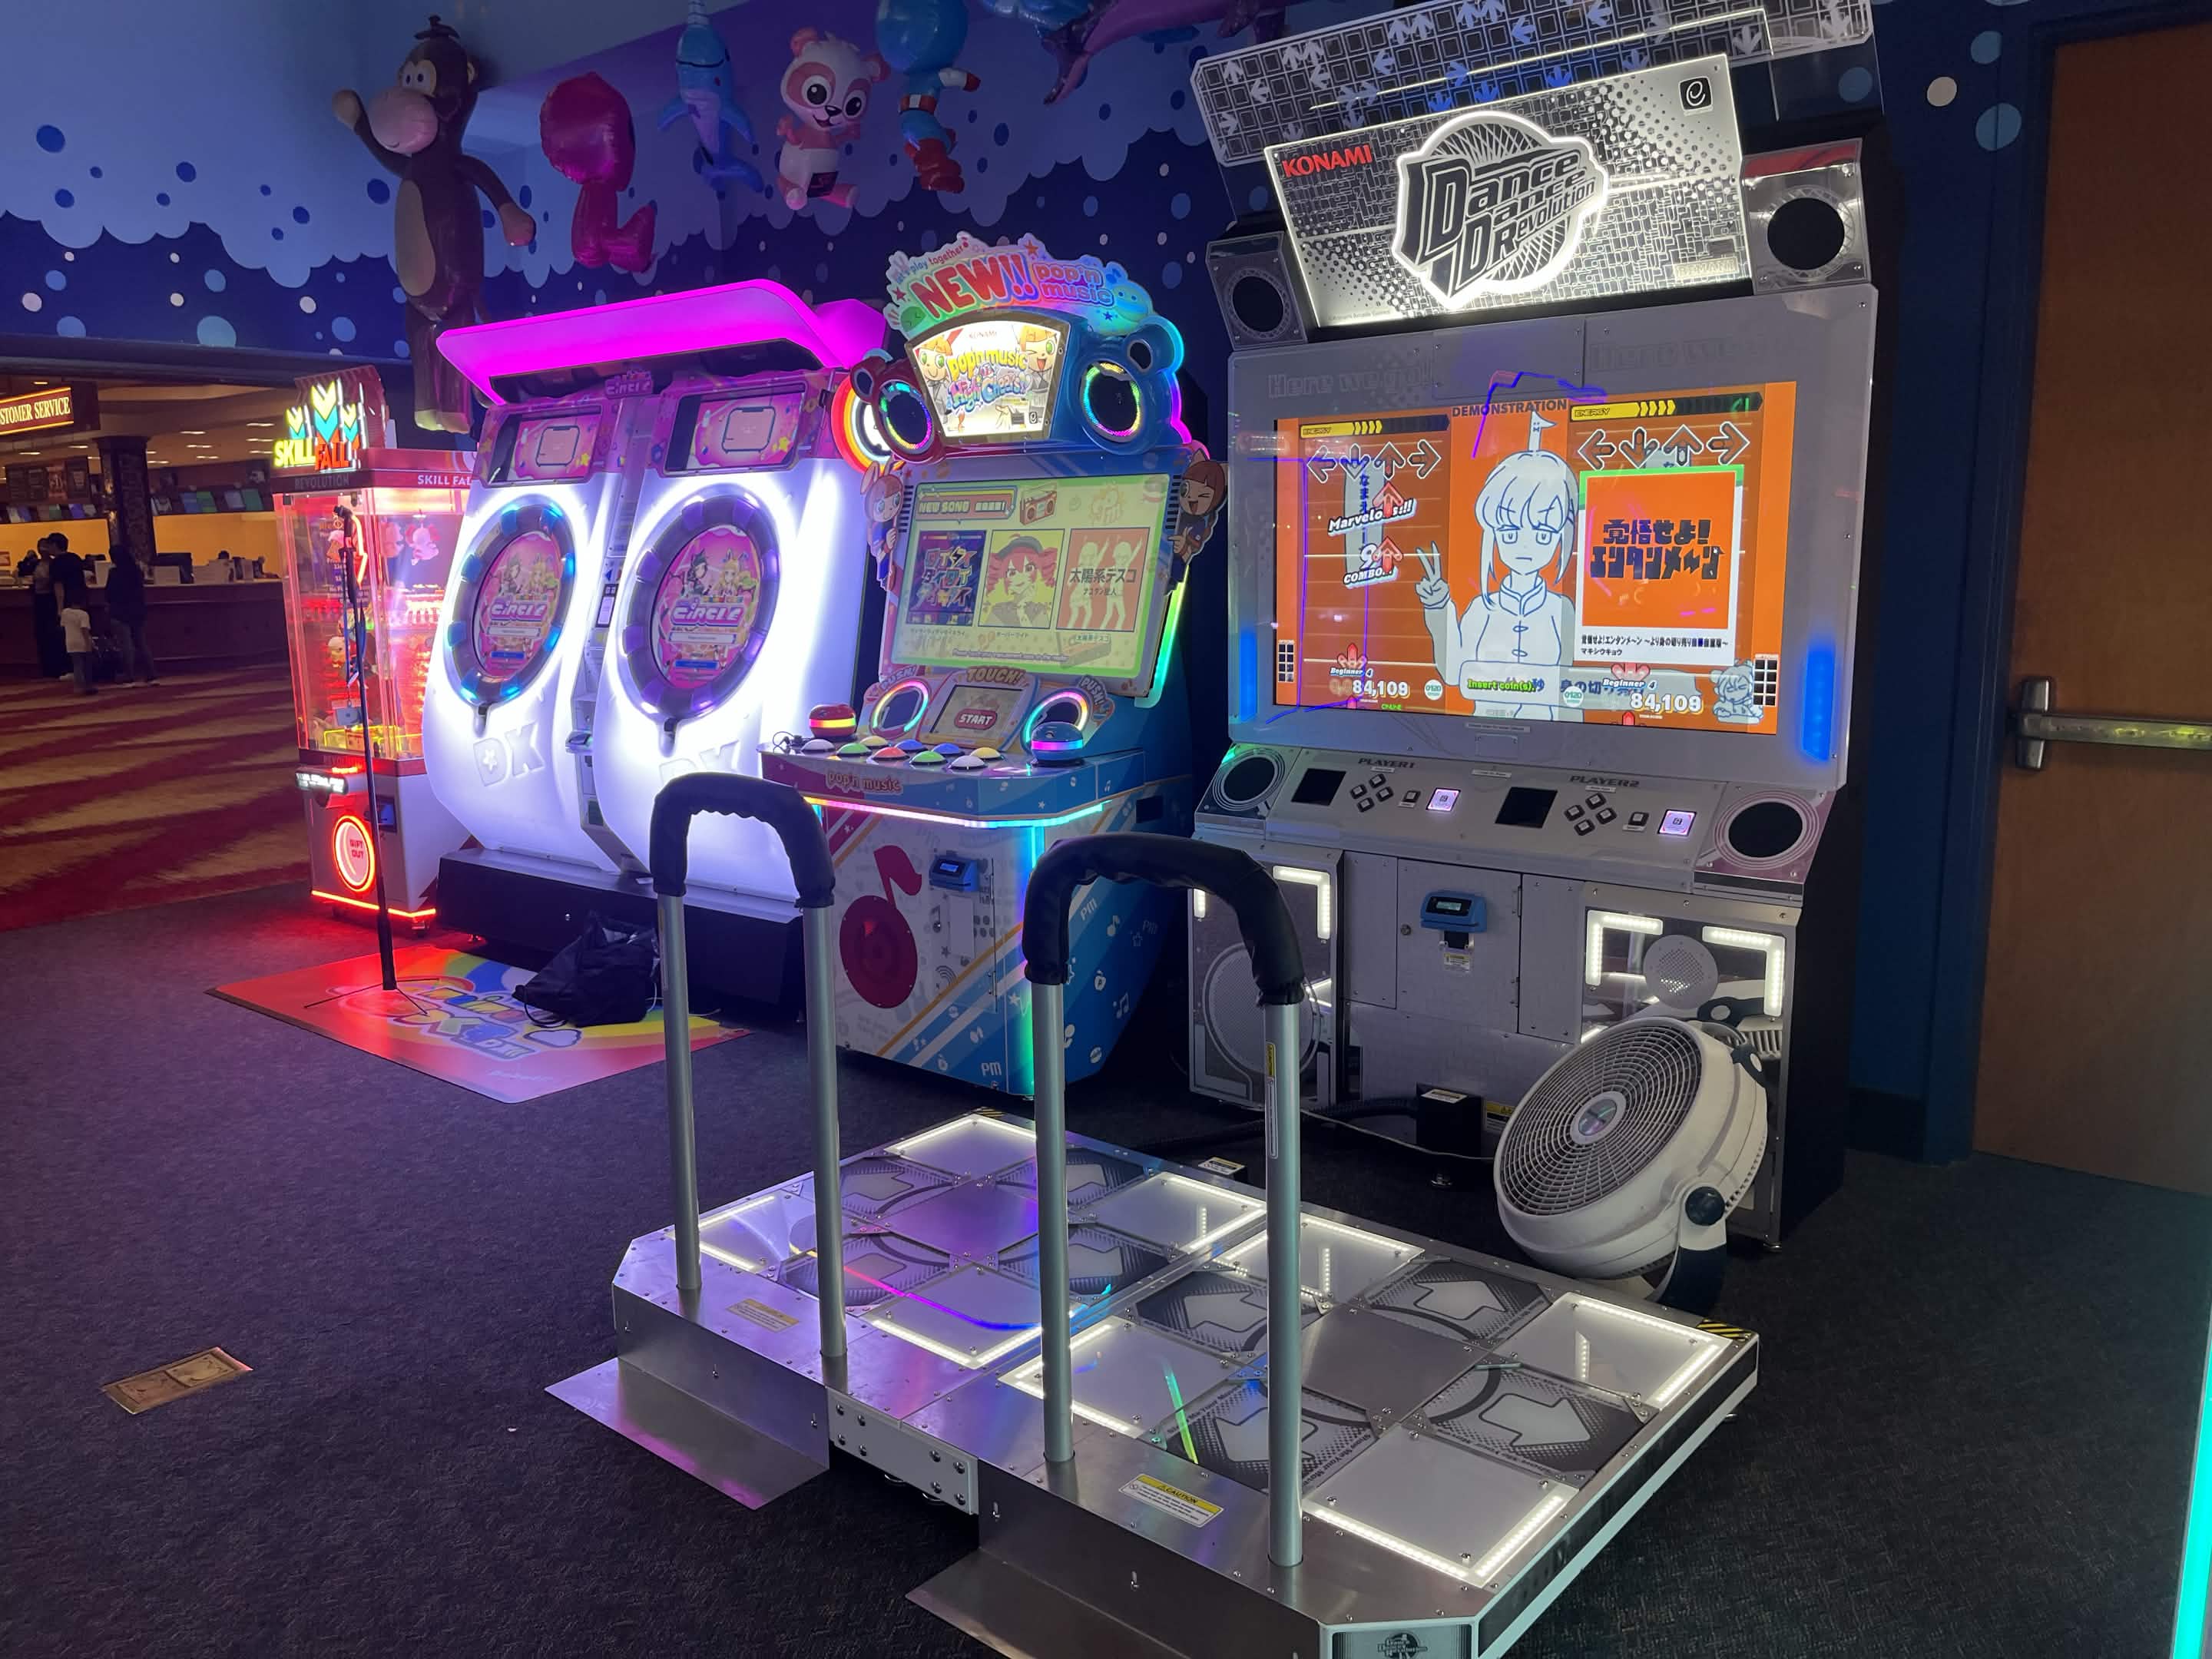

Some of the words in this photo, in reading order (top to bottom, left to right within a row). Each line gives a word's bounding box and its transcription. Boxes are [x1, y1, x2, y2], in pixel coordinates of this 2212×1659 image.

[1282, 144, 1372, 177] KONAMI
[1406, 149, 1581, 263] Dance
[1492, 177, 1596, 267] Revolution
[929, 246, 964, 265] together
[1036, 263, 1101, 283] pop'n
[909, 253, 1034, 319] NEW!!
[1041, 283, 1112, 304] music
[986, 348, 1027, 369] music
[34, 396, 71, 419] SERVICE
[1452, 399, 1568, 417] DEMONSTRATION
[274, 439, 316, 467] SKILL
[315, 440, 349, 470] FALL
[295, 475, 349, 488] REVOLUTION
[417, 475, 449, 485] SKILL
[452, 475, 472, 486] FAL
[1328, 499, 1415, 532] Marvelos!!!
[967, 668, 1024, 684] TOUCH!
[1330, 667, 1363, 677] Beginner
[1080, 677, 1104, 705] PUSH!
[1468, 679, 1498, 690] Insert
[1499, 680, 1536, 692] coin(s).
[1603, 678, 1647, 689] Beginner
[959, 714, 993, 726] START
[862, 775, 901, 792] music
[351, 849, 364, 858] OUT
[1165, 1487, 1198, 1504] CAUTION
